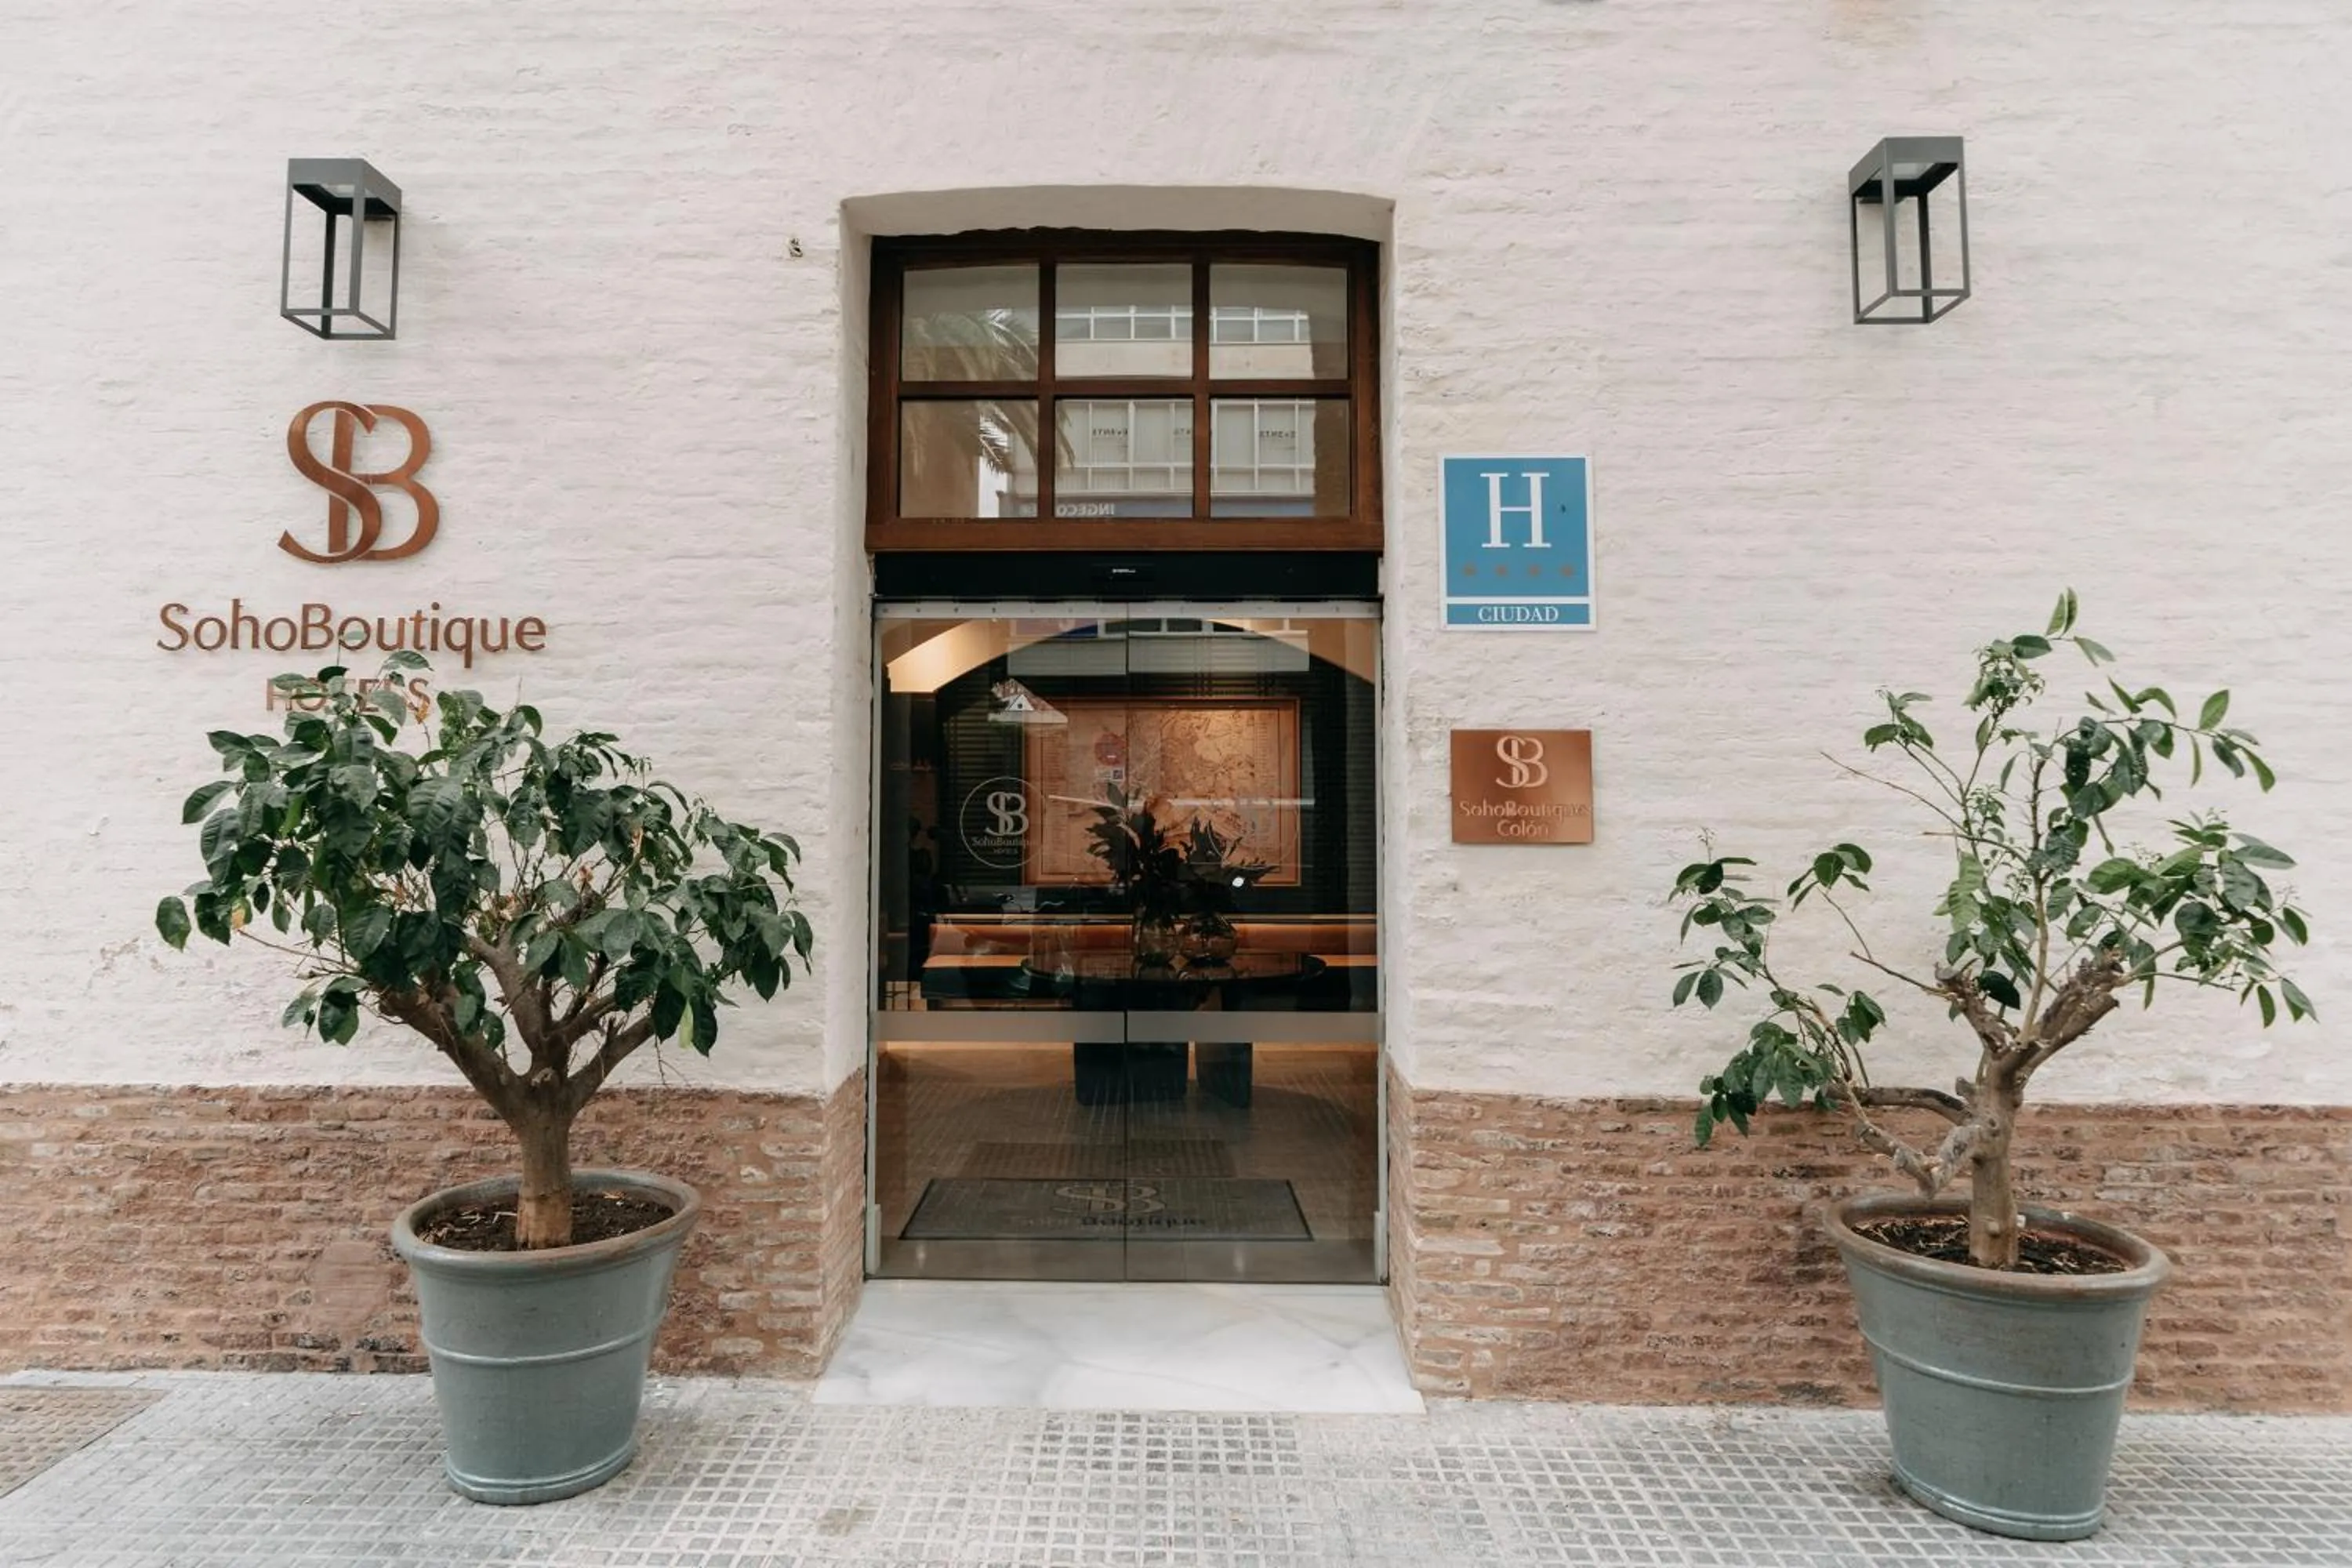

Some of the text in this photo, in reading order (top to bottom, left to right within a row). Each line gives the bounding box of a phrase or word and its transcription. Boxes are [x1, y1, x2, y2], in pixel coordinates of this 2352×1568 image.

[1479, 472, 1552, 548] H
[1478, 606, 1559, 622] CIUDAD
[156, 597, 547, 669] SohoBoutique
[267, 677, 432, 713] HOES
[1496, 818, 1549, 837] Colón
